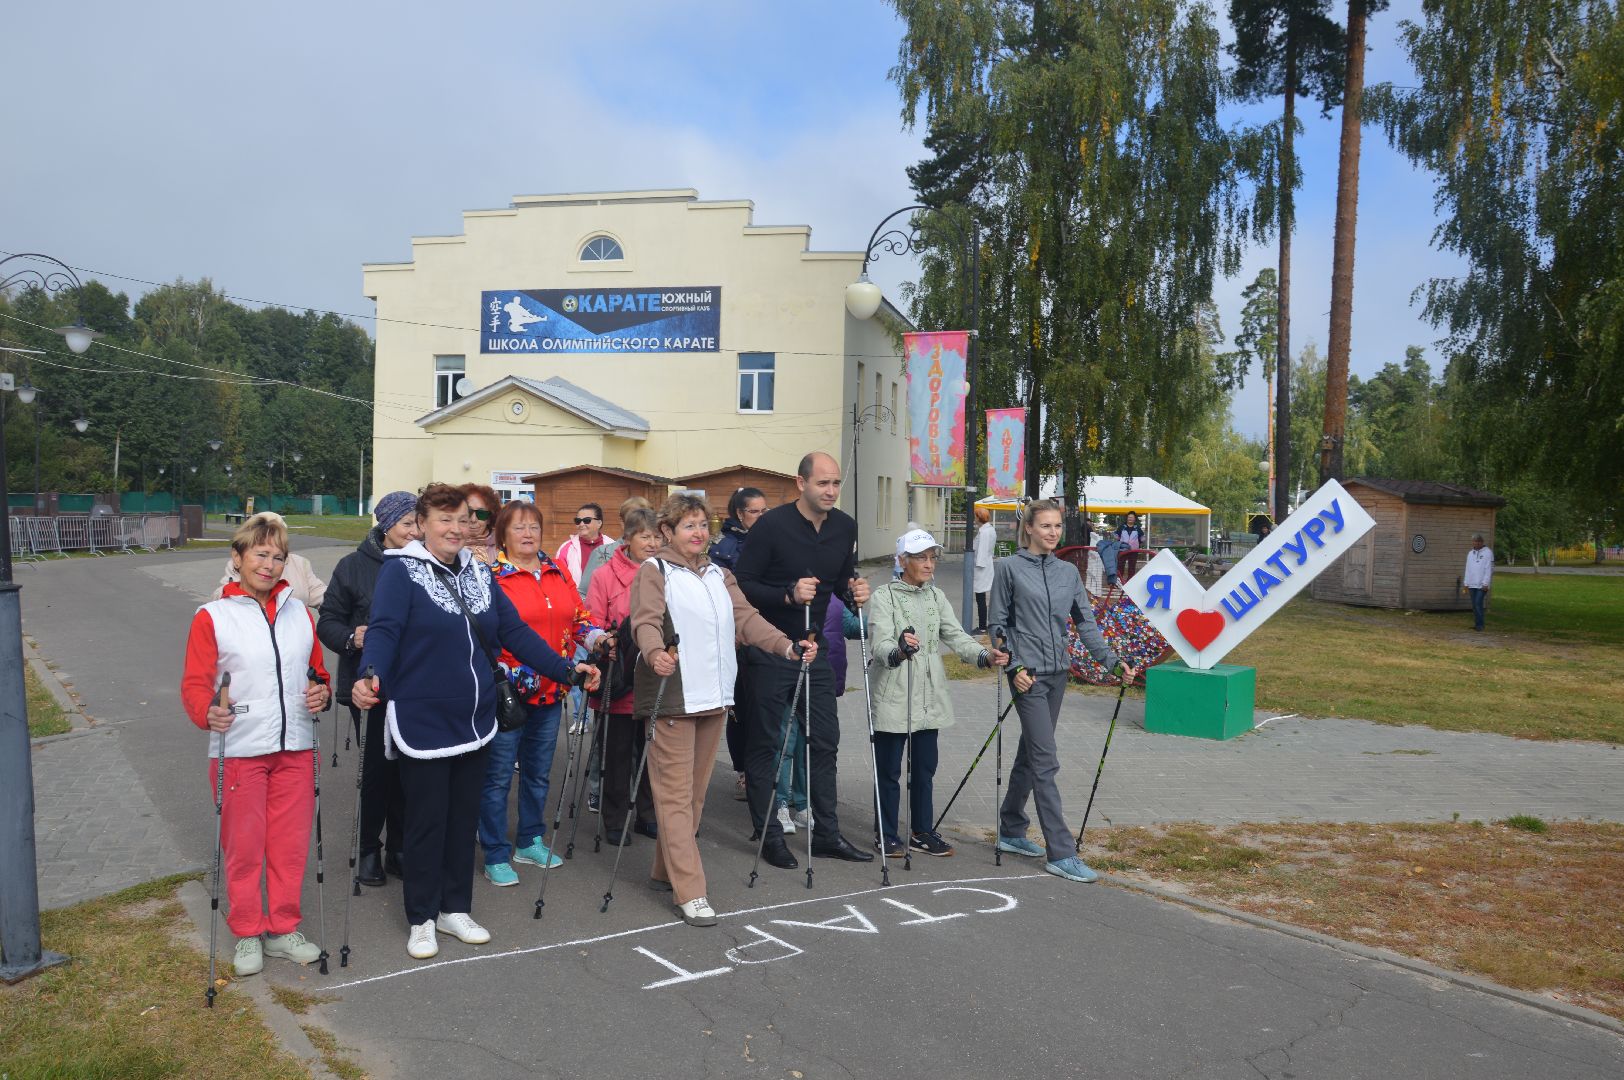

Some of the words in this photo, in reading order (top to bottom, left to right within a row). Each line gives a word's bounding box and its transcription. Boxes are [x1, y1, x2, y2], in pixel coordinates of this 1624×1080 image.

[578, 293, 661, 313] КАРАТЕ
[661, 290, 712, 304] ЮЖНЫЙ
[488, 338, 539, 351] ШКОЛА
[541, 335, 660, 351] ОЛИМПИЙСКОГО
[663, 337, 715, 350] КАРАТЕ
[1145, 574, 1173, 609] Я
[1220, 497, 1345, 622] ШАТУРУ
[631, 886, 1019, 991] СТАРТ
